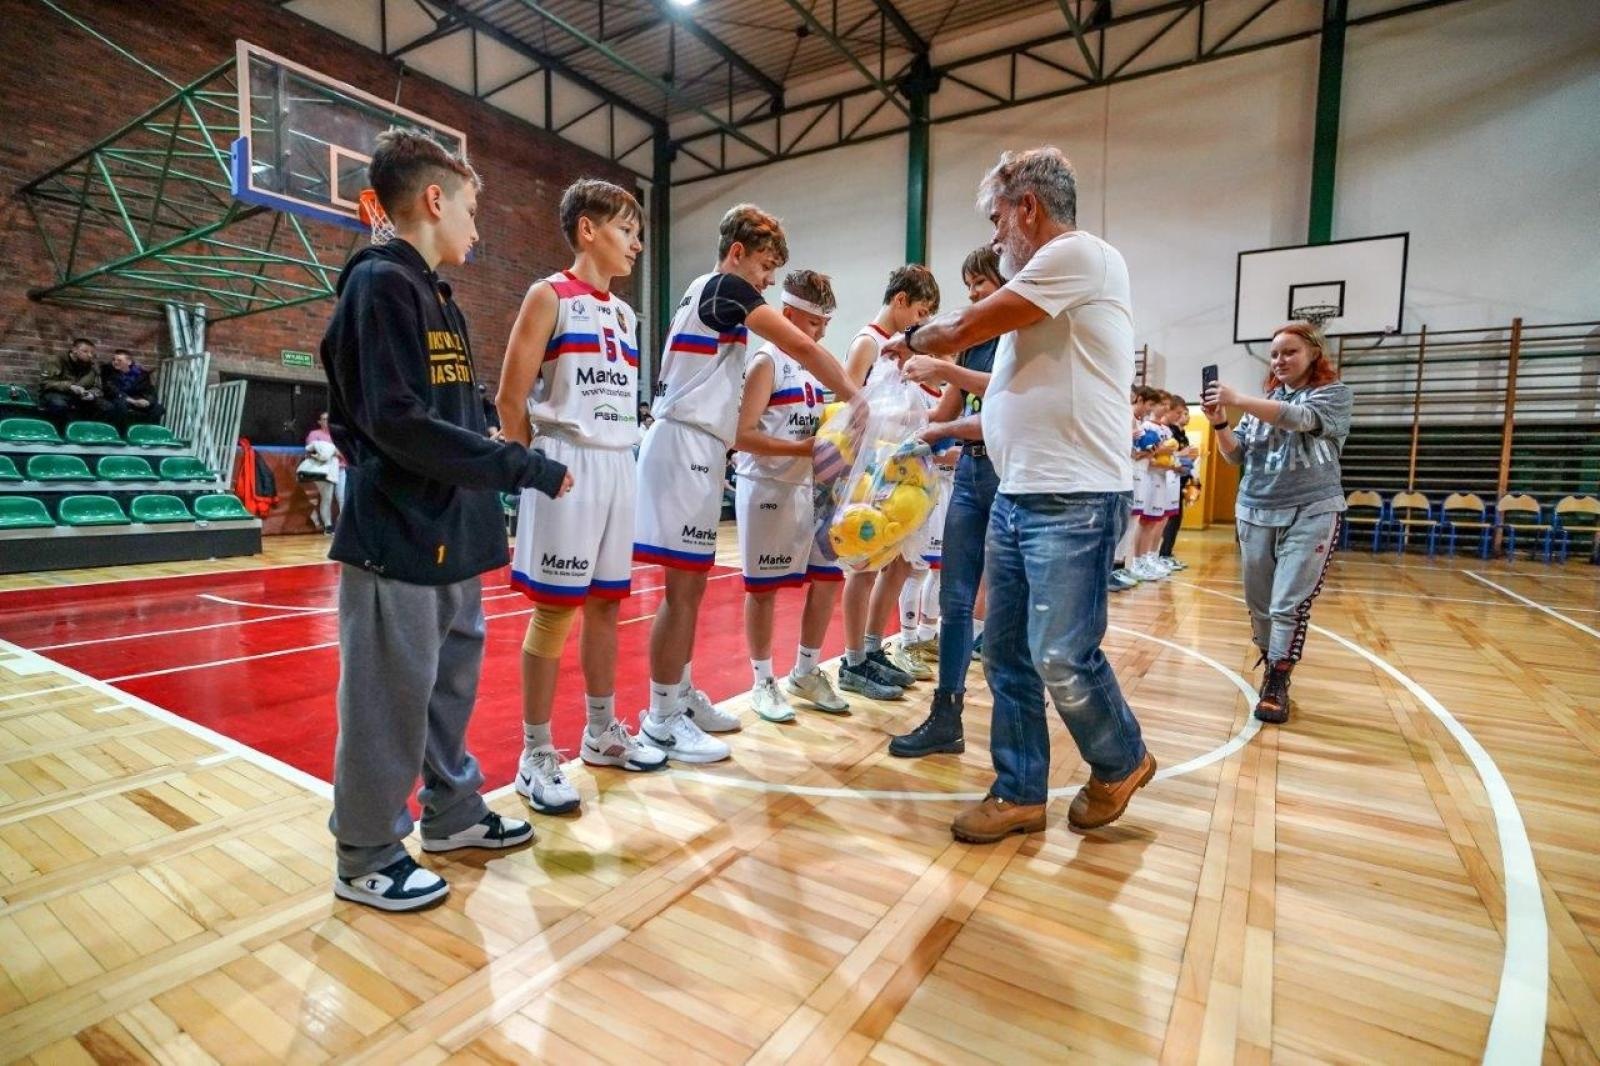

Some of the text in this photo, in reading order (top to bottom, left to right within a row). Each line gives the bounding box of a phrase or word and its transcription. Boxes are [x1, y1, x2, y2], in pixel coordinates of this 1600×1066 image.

[603, 327, 617, 363] 5
[576, 367, 628, 386] Marko
[541, 553, 589, 570] Marko
[758, 554, 792, 565] Marko
